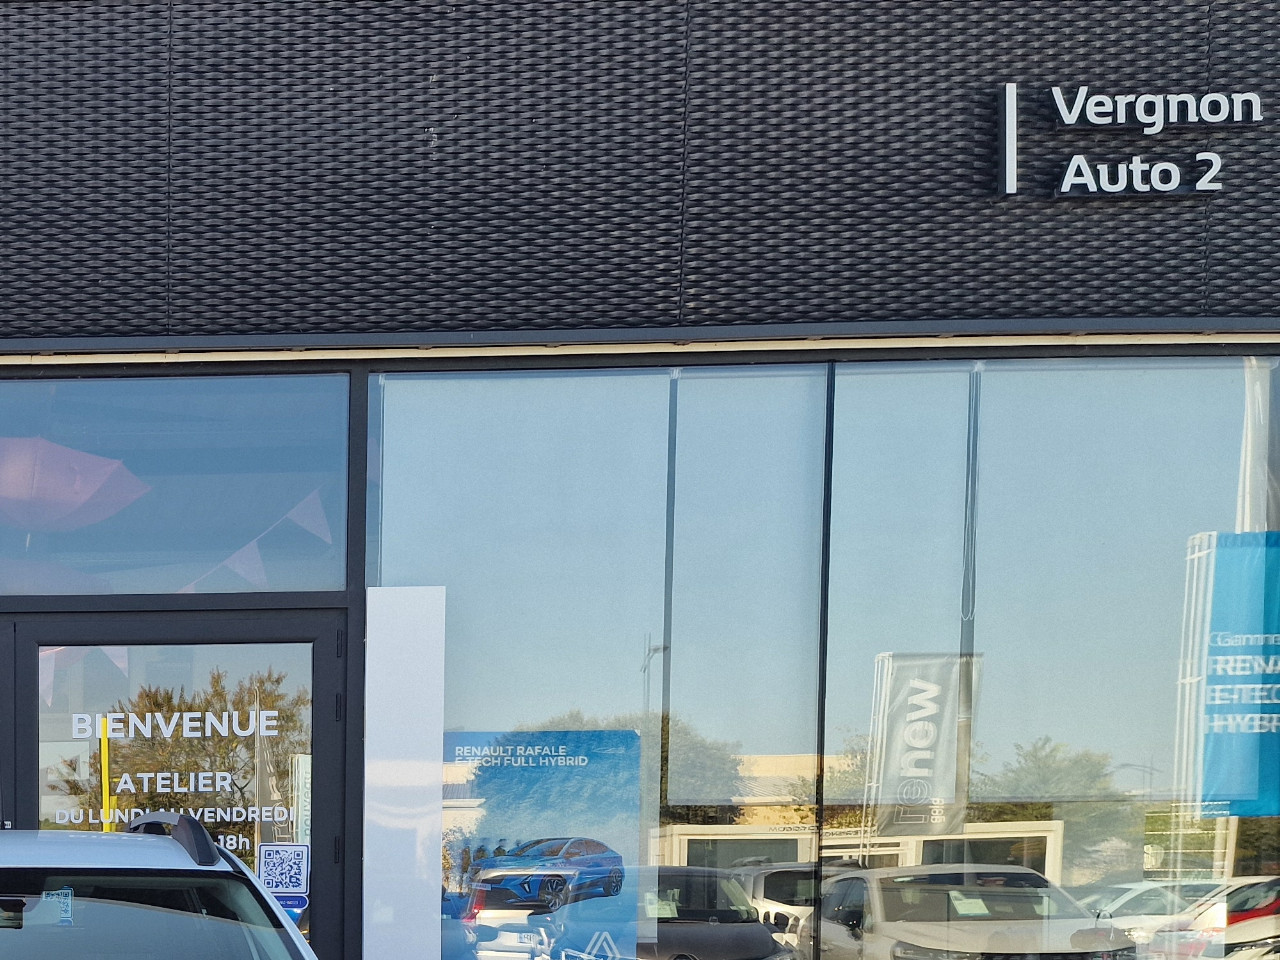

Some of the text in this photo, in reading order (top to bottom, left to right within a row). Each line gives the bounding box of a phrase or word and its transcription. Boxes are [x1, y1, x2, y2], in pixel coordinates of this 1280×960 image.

[1051, 86, 1263, 135] Vergnon
[1060, 152, 1223, 193] Auto 2
[72, 710, 279, 739] BIENVENUE
[455, 745, 567, 756] RENAULT RAFALE
[504, 757, 536, 767] FULL
[539, 756, 589, 766] HYBRID
[116, 772, 233, 793] ATELIER
[55, 808, 84, 824] DU
[187, 806, 294, 823] VENDREDI
